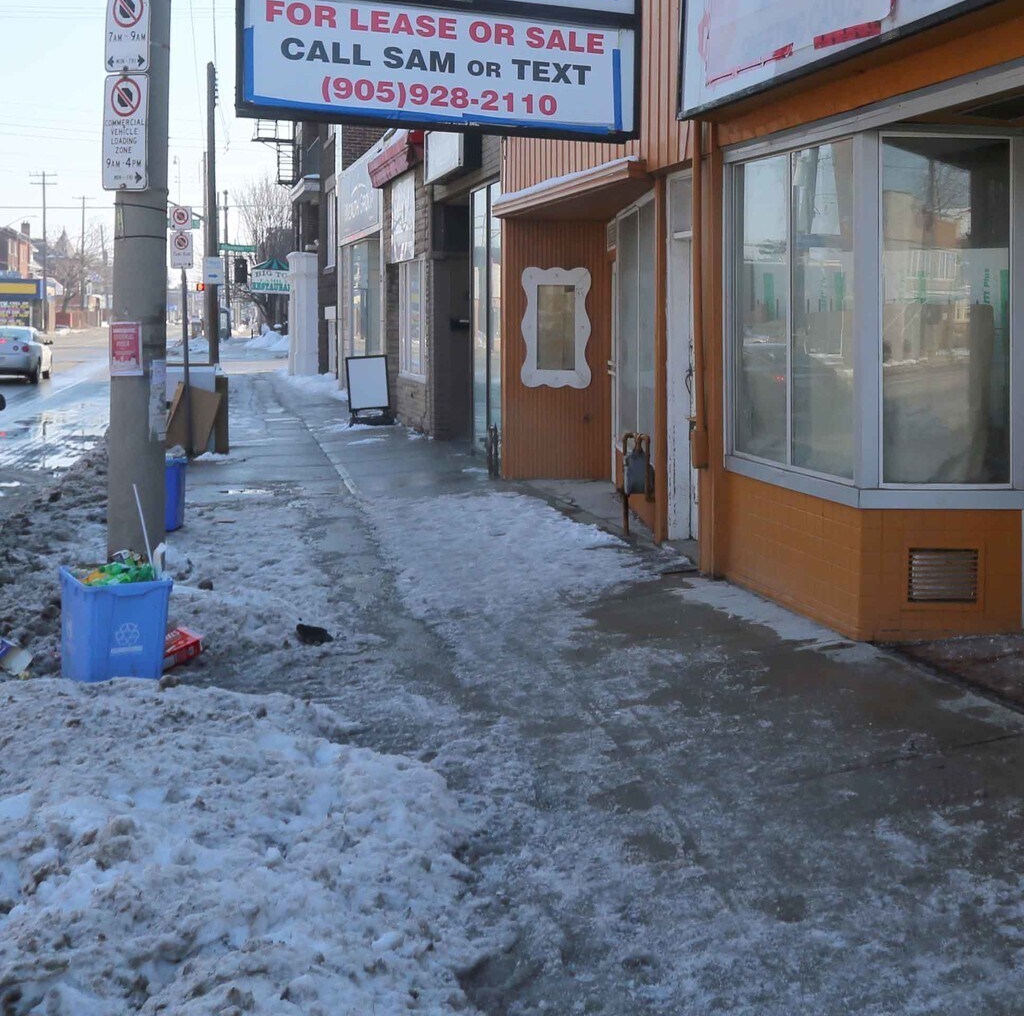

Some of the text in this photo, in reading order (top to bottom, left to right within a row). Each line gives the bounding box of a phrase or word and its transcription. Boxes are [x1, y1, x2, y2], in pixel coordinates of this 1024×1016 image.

[265, 0, 604, 55] FOR LEASE OR SALE
[280, 37, 591, 86] CALL SAM OR TEXT
[321, 76, 557, 117] (905)928-2110
[105, 119, 144, 127] COMMERCIAL
[110, 128, 139, 136] VEHICLE
[111, 137, 137, 145] LOADING
